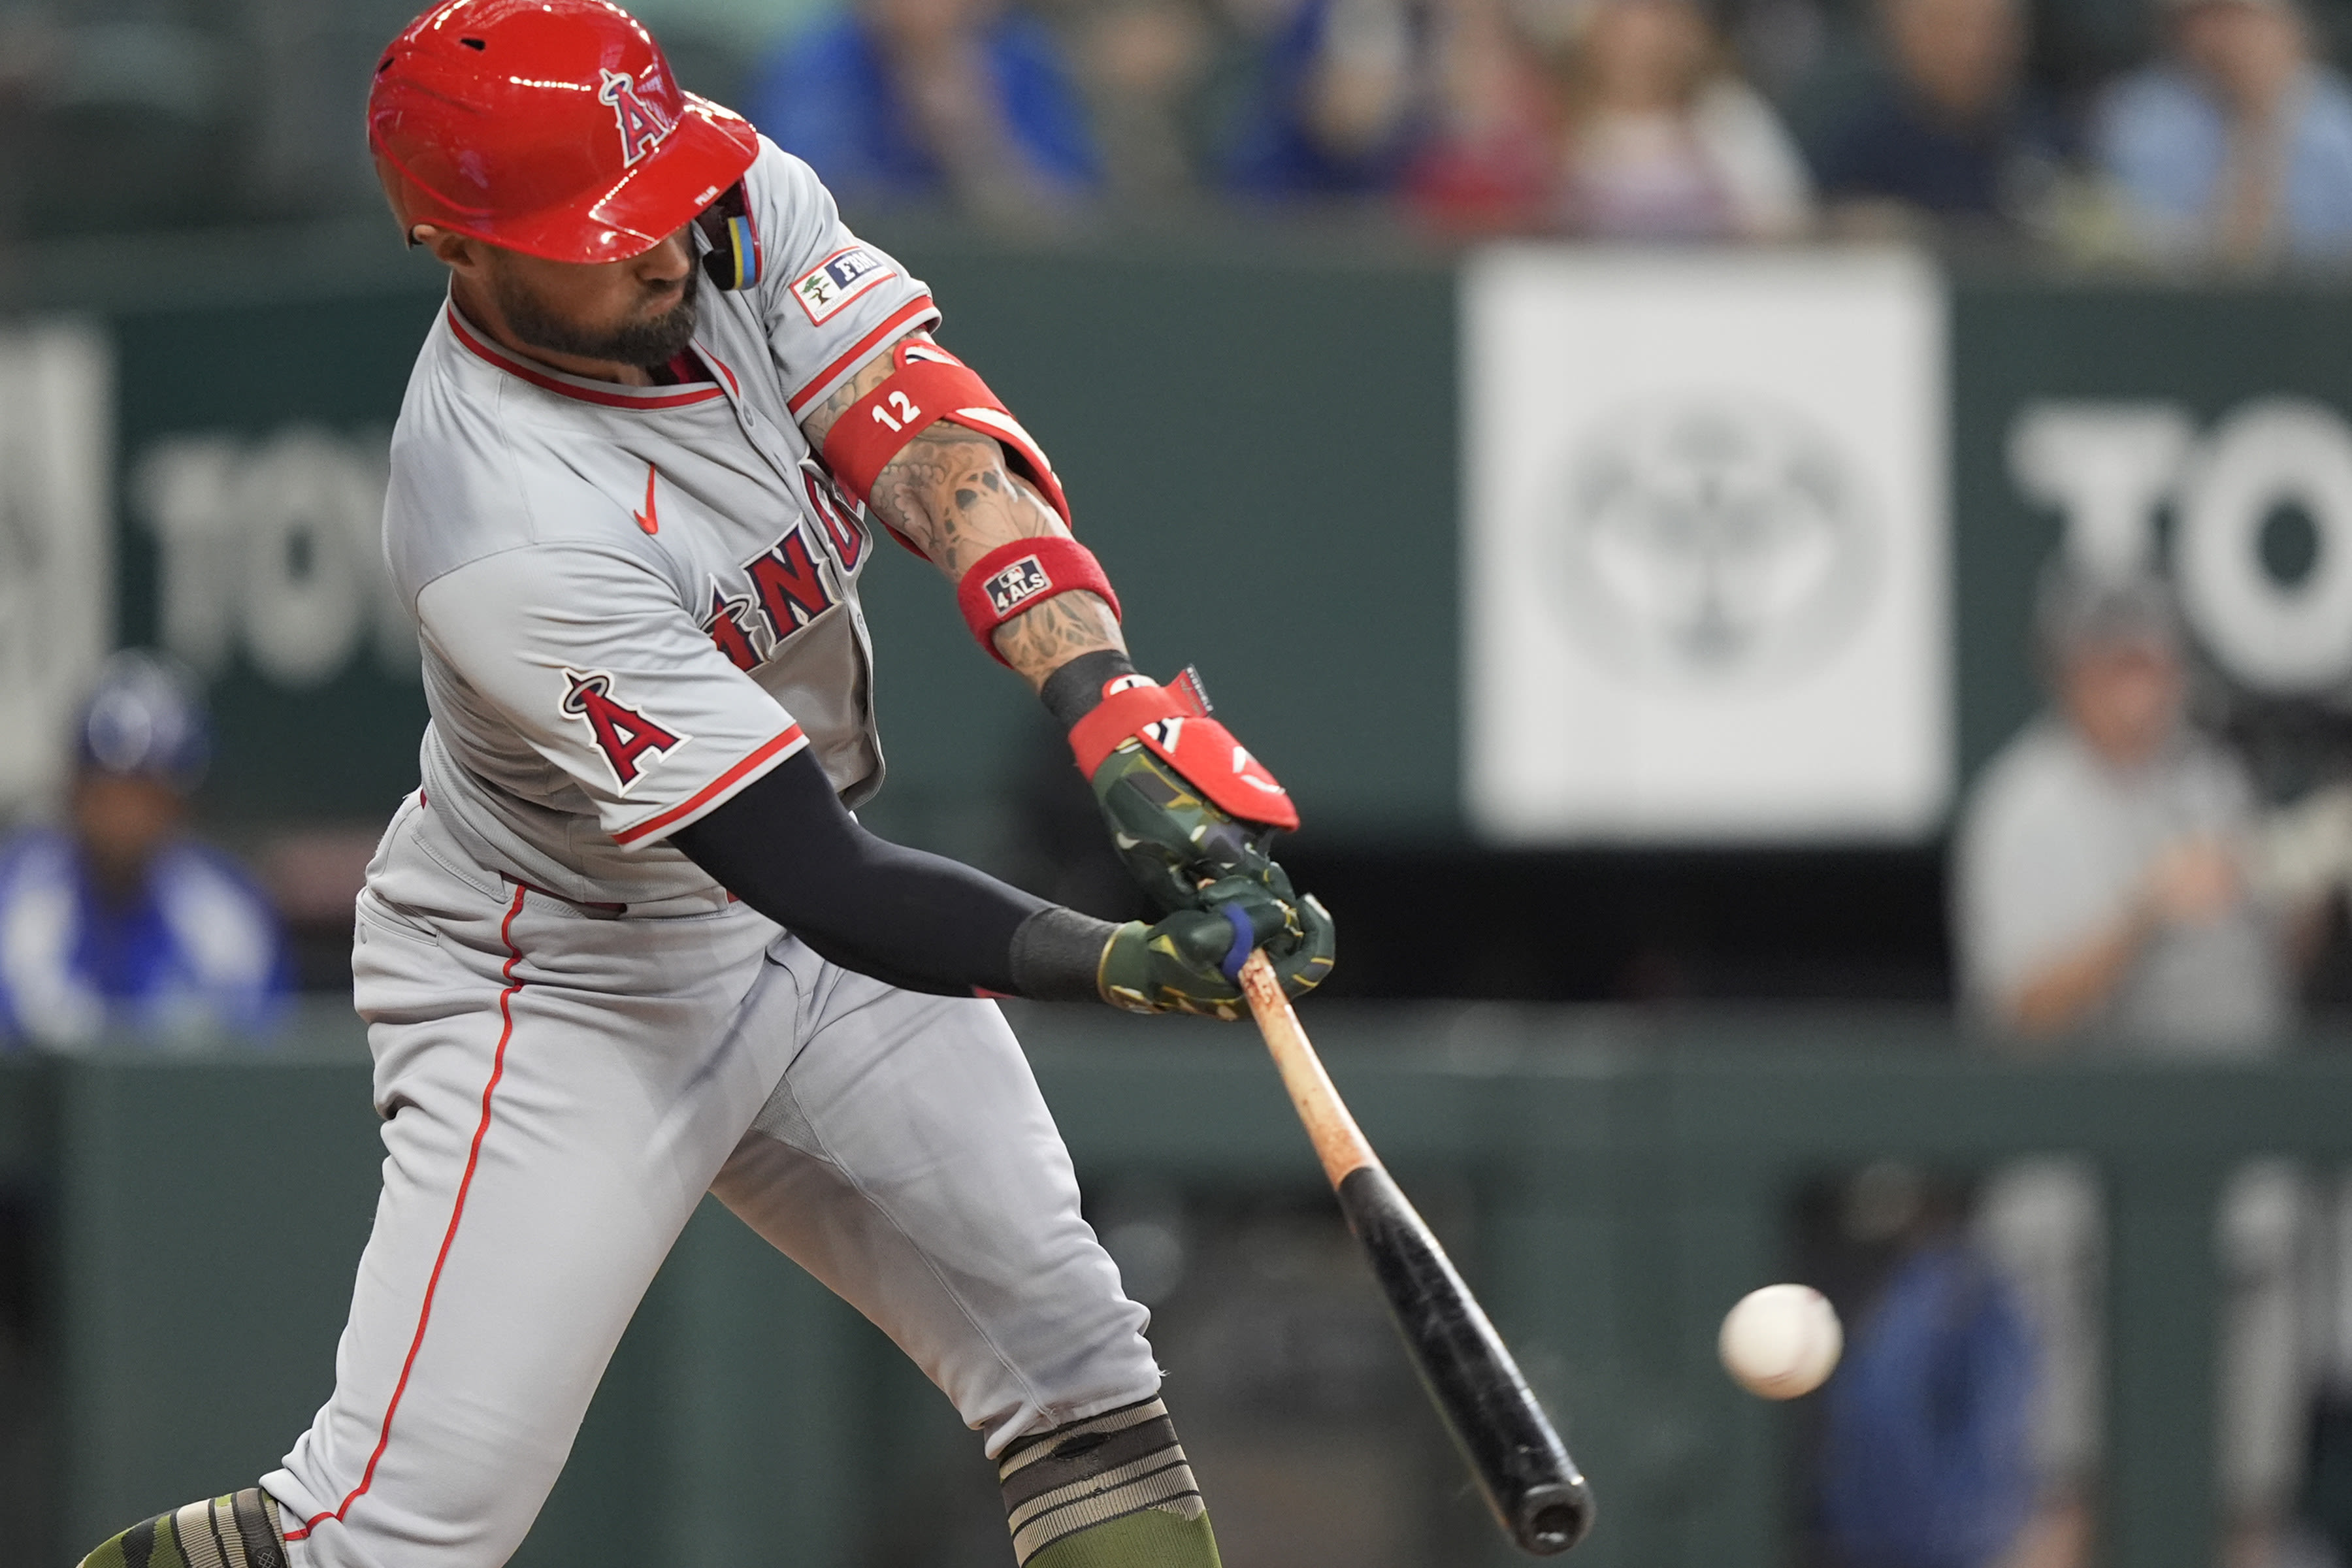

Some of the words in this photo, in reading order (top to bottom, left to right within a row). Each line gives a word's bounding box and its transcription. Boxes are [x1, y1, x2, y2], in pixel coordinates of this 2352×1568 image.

[598, 68, 670, 169] A
[834, 250, 878, 282] FBM
[872, 391, 921, 433] 12
[559, 668, 694, 798] A
